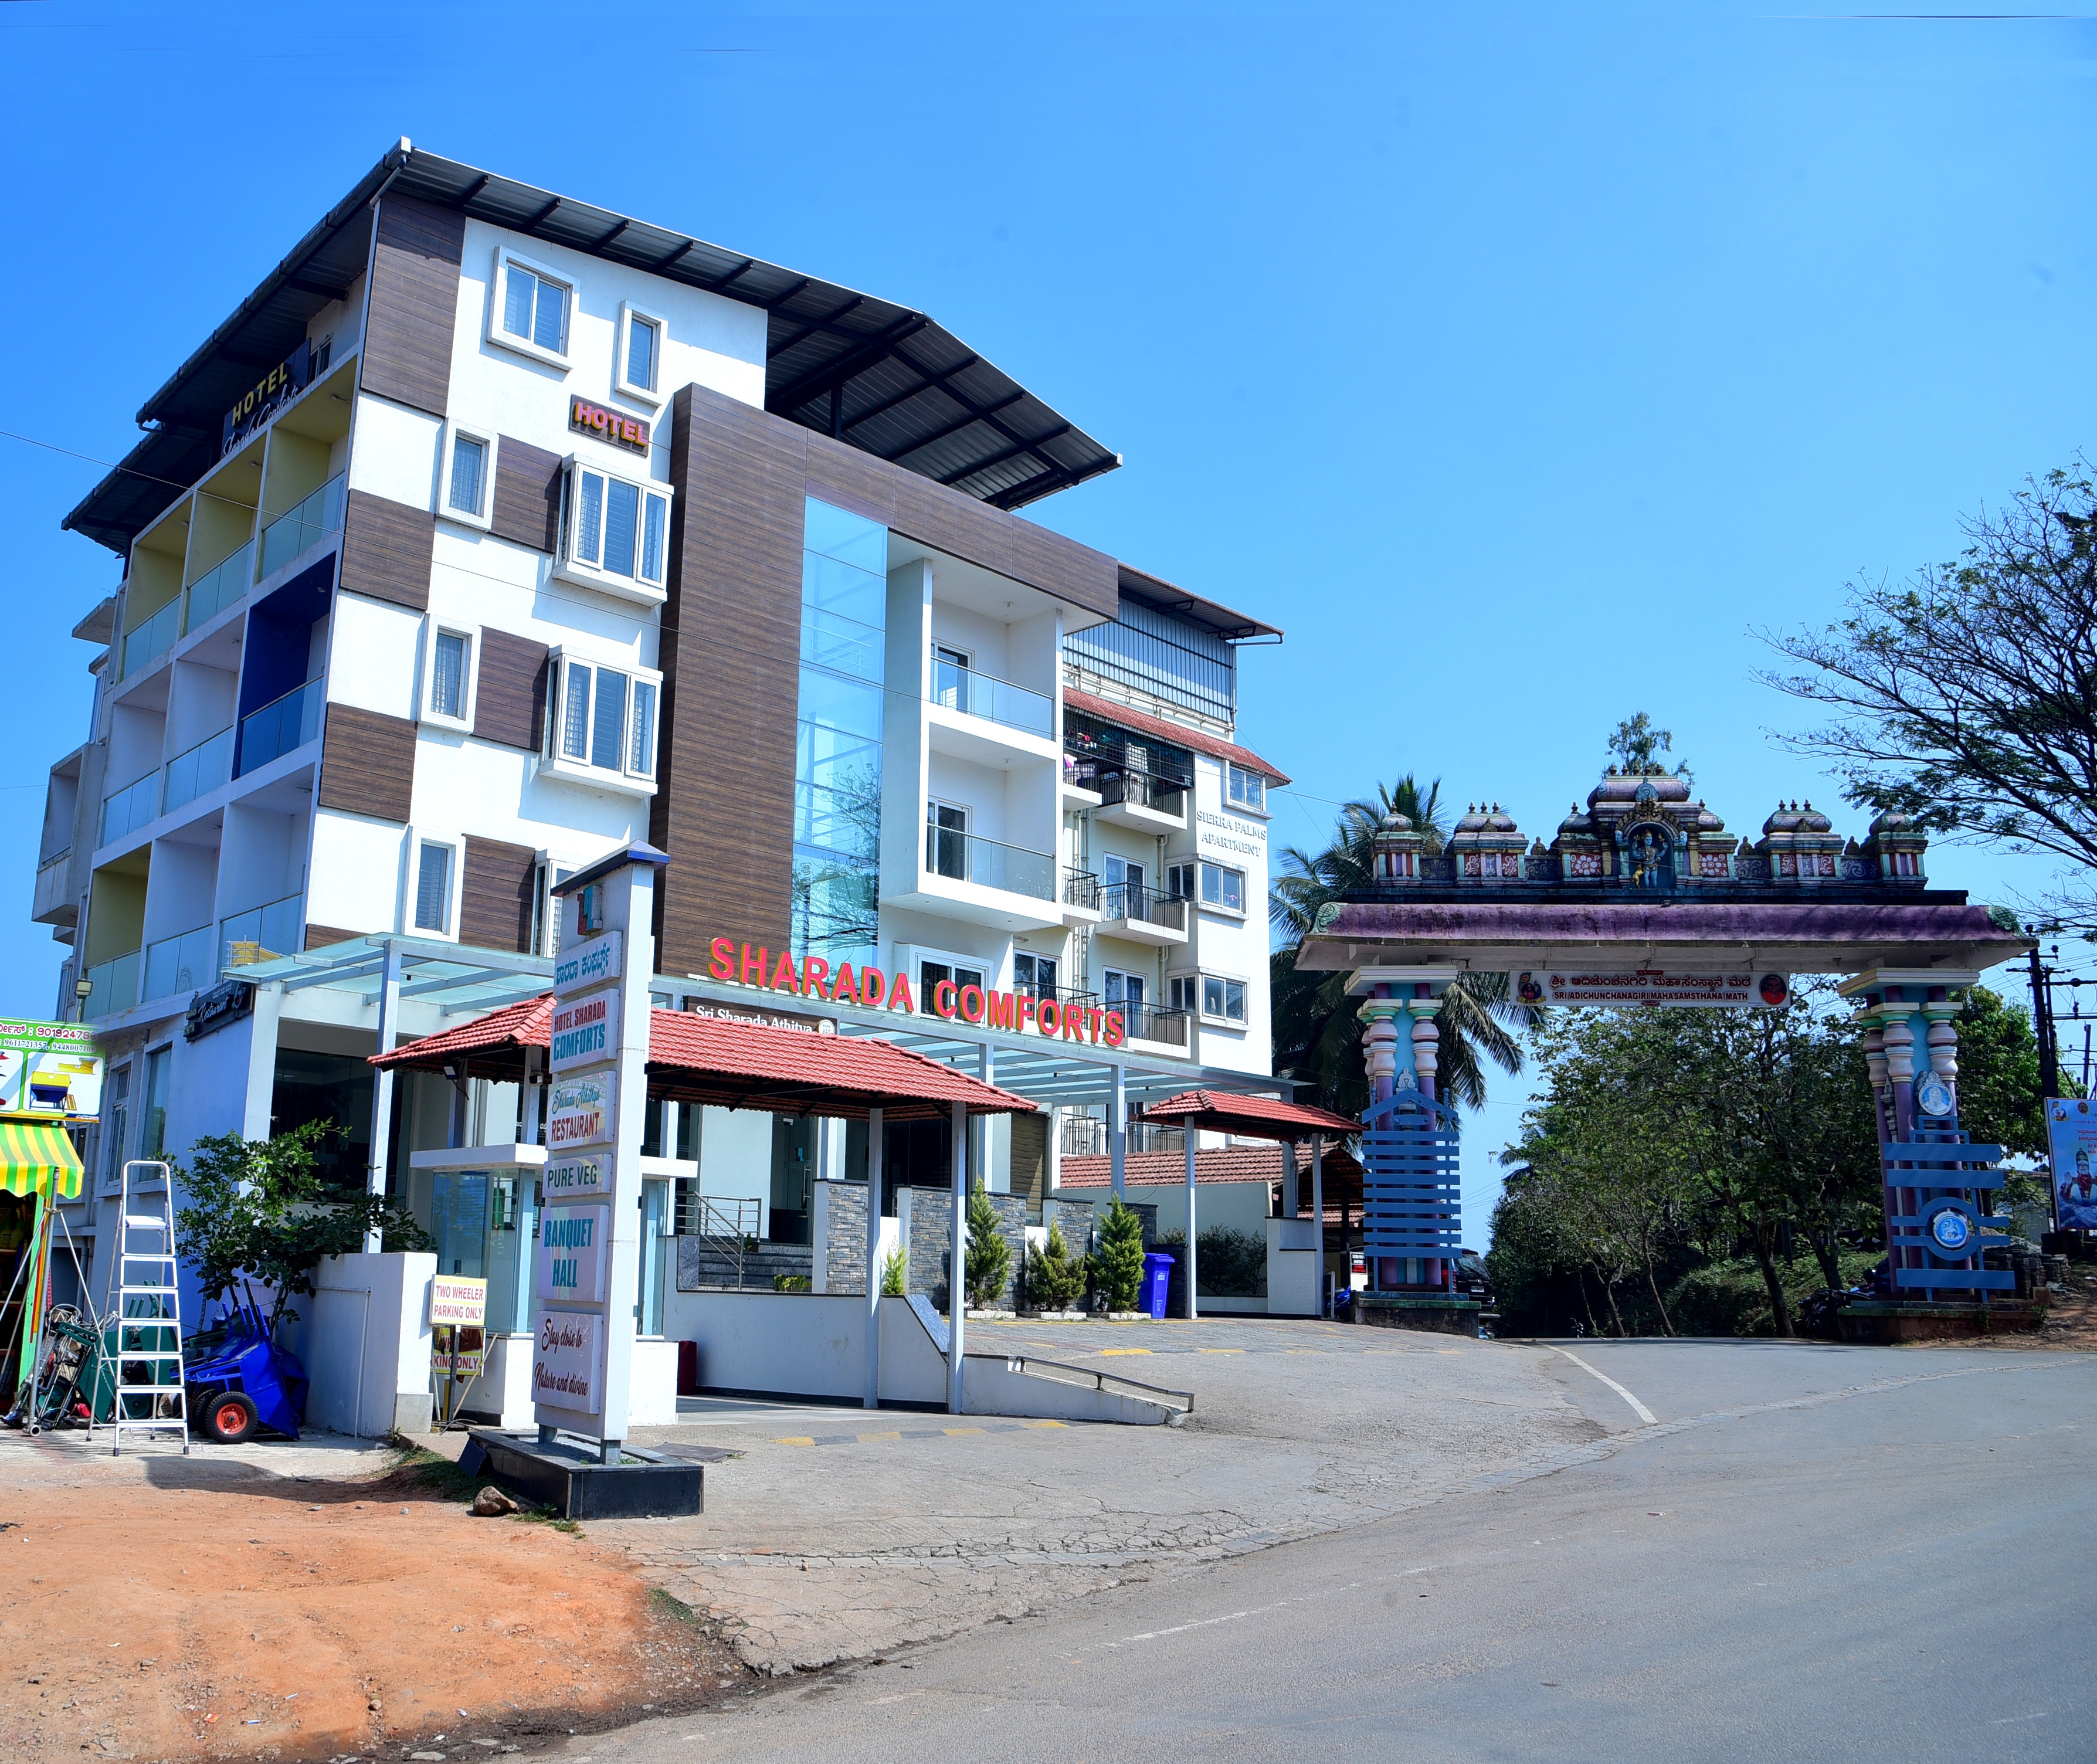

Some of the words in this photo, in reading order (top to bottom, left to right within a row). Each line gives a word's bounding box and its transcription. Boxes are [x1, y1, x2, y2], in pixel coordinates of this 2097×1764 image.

[232, 362, 287, 427] HOTEL
[575, 402, 649, 446] HOTEL
[1196, 810, 1233, 830] SIERRA
[1235, 822, 1266, 840] PALMS
[1202, 832, 1260, 857] APARTMENT
[707, 937, 915, 1012] SHARADA
[934, 979, 1123, 1046] COMFORTS
[1550, 975, 1566, 989] ಶ್ರೀ
[1554, 991, 1567, 1000] SRI
[1569, 991, 1648, 1000] ADICHUNCHANAGIRI
[1650, 991, 1723, 1000] MAHASAMSTHANA
[1725, 991, 1748, 1000] MATH
[554, 1010, 572, 1033] HOTEL
[575, 1000, 606, 1026] SHARADA
[696, 1005, 714, 1019] Sri
[717, 1009, 768, 1026] Sharada
[554, 1023, 605, 1061] COMFORTS
[551, 1111, 600, 1142] RESTAURANT
[547, 1167, 574, 1189] PURE
[577, 1164, 598, 1186] VEG
[544, 1218, 594, 1251] BANQUET
[552, 1259, 577, 1288] HALL
[436, 1285, 450, 1298] TWO
[453, 1286, 483, 1301] WHEELER
[434, 1304, 463, 1318] PARKING
[465, 1307, 483, 1319] ONLY
[541, 1318, 560, 1354] Stay
[560, 1324, 575, 1348] close
[575, 1326, 583, 1348] to
[457, 1356, 479, 1370] ONLY
[534, 1361, 557, 1392] Nature
[557, 1371, 569, 1393] and
[568, 1372, 589, 1396] divine
